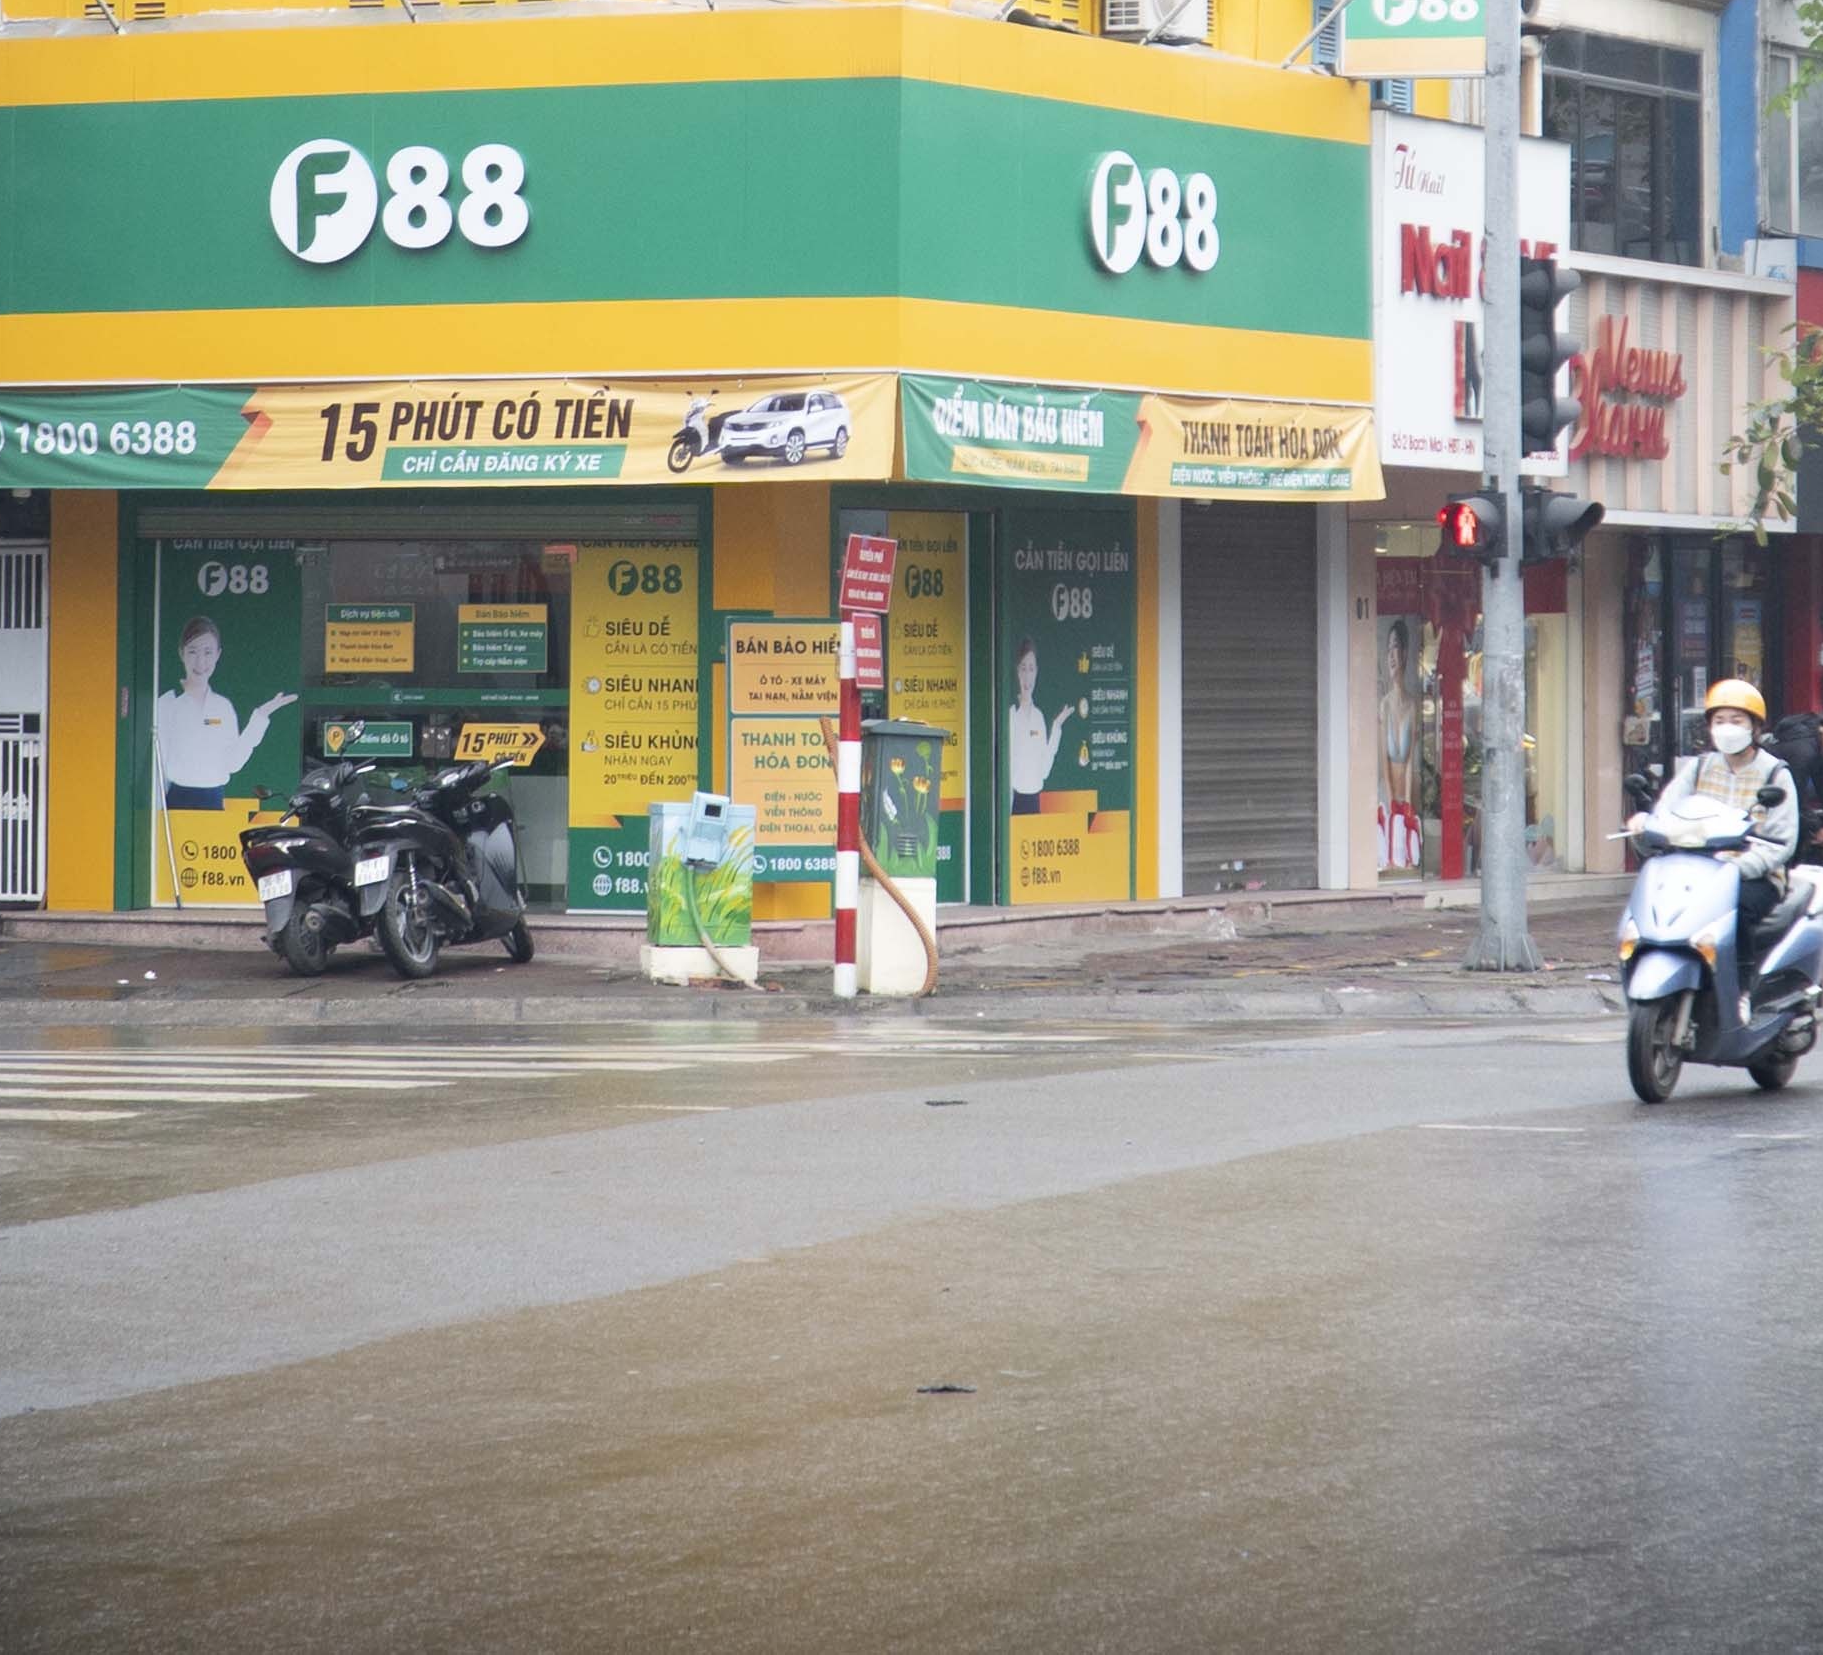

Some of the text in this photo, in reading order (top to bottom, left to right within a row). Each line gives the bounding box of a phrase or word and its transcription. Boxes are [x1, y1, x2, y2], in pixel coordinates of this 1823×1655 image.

[270, 138, 531, 265] F88
[1090, 149, 1220, 274] F88
[1400, 223, 1472, 299] Nail
[319, 384, 634, 464] 15 PHÚT CÓ TIỀN
[933, 386, 1104, 447] ĐIỂM BÁN BẢO HIỂM
[13, 419, 197, 457] 1800 6388
[1181, 419, 1343, 460] THANH TOÁN HÓA ĐƠN
[401, 447, 602, 477] CHỈ CẦN ĐĂNG KÝ XE
[1077, 550, 1100, 578] GỌI
[198, 562, 269, 596] F88
[608, 560, 683, 596] F88
[906, 565, 944, 598] F88
[1052, 583, 1093, 621] F88
[605, 615, 670, 636] SIÊU DỄ
[736, 636, 807, 654] BÁN BẢO
[605, 674, 642, 692] SIÊU
[791, 676, 802, 685] XE
[927, 679, 957, 691] NHANH
[657, 700, 668, 710] 15
[462, 732, 517, 753] 15 PHÚT
[605, 731, 642, 748] SIÊU
[742, 733, 795, 746] THANH
[640, 755, 672, 766] NGAY
[754, 752, 833, 768] HÓA ĐƠN
[640, 772, 664, 785] ĐẾN
[203, 845, 237, 861] 1800
[1032, 839, 1080, 858] 1800 6388
[769, 857, 802, 871] 1800
[201, 871, 245, 888] f88.vn
[1031, 867, 1061, 886] f88.vn
